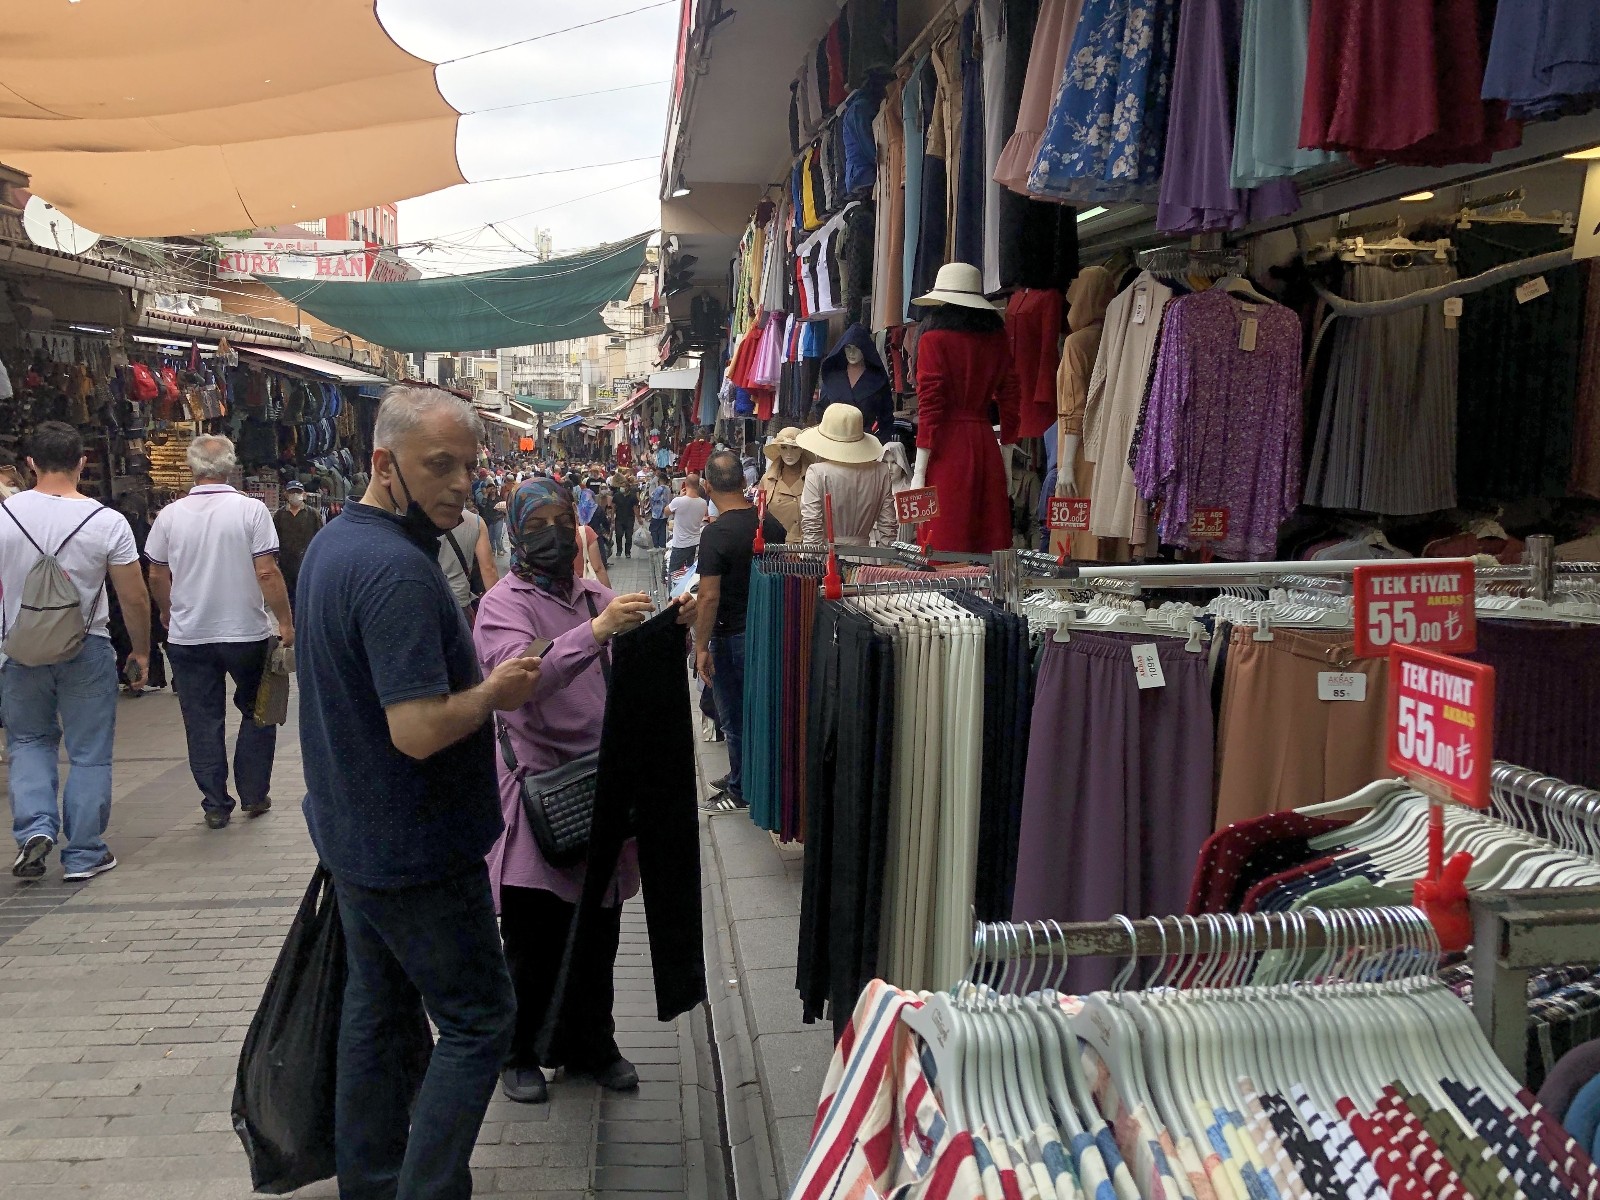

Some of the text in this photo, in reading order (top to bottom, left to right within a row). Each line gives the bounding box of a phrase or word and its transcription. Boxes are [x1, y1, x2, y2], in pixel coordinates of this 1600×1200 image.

[316, 256, 364, 277] HAN
[1370, 573, 1461, 595] TEK FİYAT
[1401, 661, 1474, 706] TEK FİYAT
